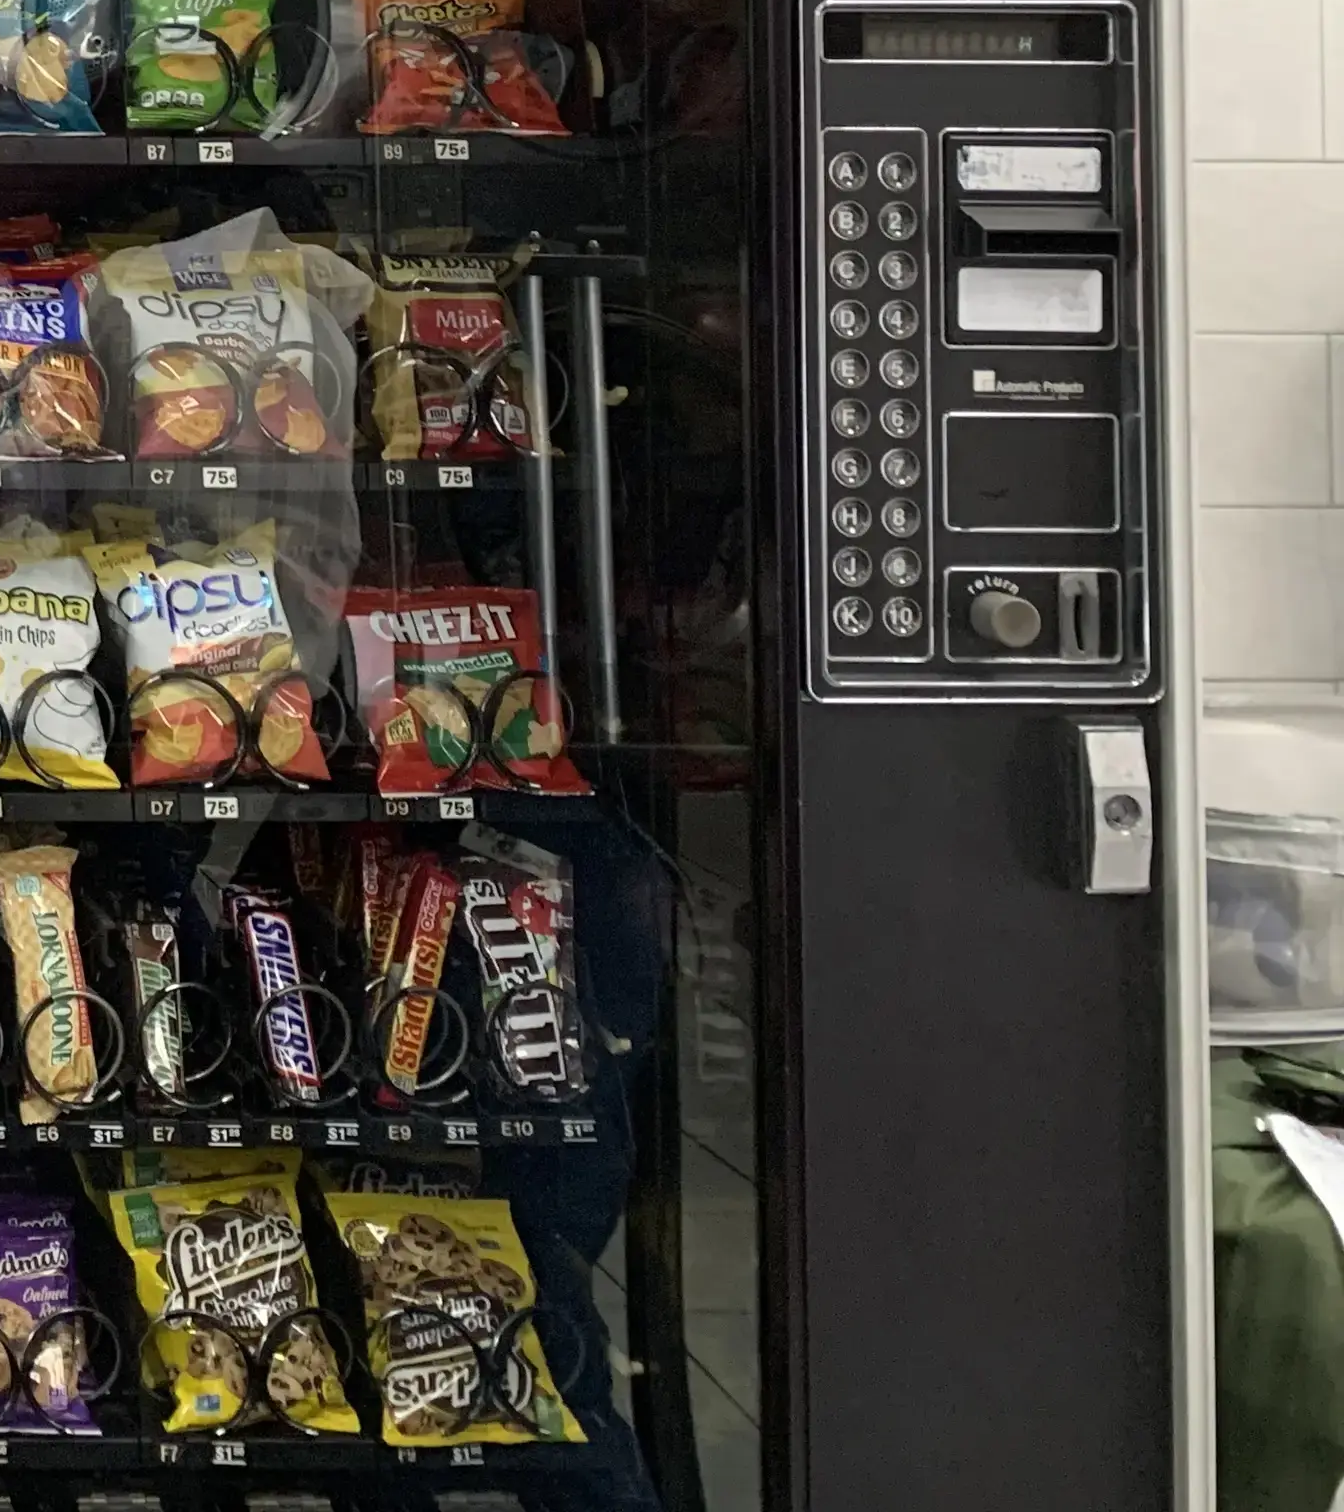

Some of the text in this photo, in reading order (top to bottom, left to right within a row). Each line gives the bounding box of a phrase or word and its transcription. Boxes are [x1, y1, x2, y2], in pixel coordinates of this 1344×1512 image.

[147, 145, 166, 160] B7
[202, 145, 232, 161] 75¢
[384, 143, 403, 159] B9
[437, 143, 466, 156] 75¢
[840, 162, 854, 180] A
[890, 163, 901, 180] 1
[840, 212, 853, 230] B
[889, 212, 901, 230] 2
[839, 261, 855, 279] C
[890, 261, 901, 279] 3
[138, 289, 286, 344] dipsy
[436, 309, 489, 329] Mini
[840, 309, 855, 328] D
[890, 309, 902, 327] 4
[841, 359, 854, 377] E
[891, 359, 903, 377] 5
[842, 408, 855, 426] F
[891, 408, 904, 426] 6
[841, 458, 857, 477] G
[892, 458, 904, 476] 7
[150, 470, 175, 485] C7
[207, 470, 237, 485] 75¢
[386, 469, 405, 485] C9
[442, 470, 471, 484] 75¢
[842, 508, 857, 526] H
[893, 508, 905, 526] 8
[844, 556, 856, 575] J
[967, 574, 1020, 595] return
[117, 570, 283, 635] dipsy
[844, 606, 858, 625] K
[892, 606, 912, 625] 10
[17, 625, 56, 647] Chips
[446, 651, 512, 673] cheddar
[151, 801, 174, 816] D7
[208, 802, 237, 816] 75¢
[386, 802, 409, 816] D9
[36, 1127, 59, 1142] E6
[153, 1127, 175, 1142] E7
[270, 1126, 294, 1141] E8
[388, 1126, 411, 1141] E9
[501, 1123, 534, 1138] E10
[167, 1215, 304, 1310] Linden's
[161, 1446, 178, 1461] F7
